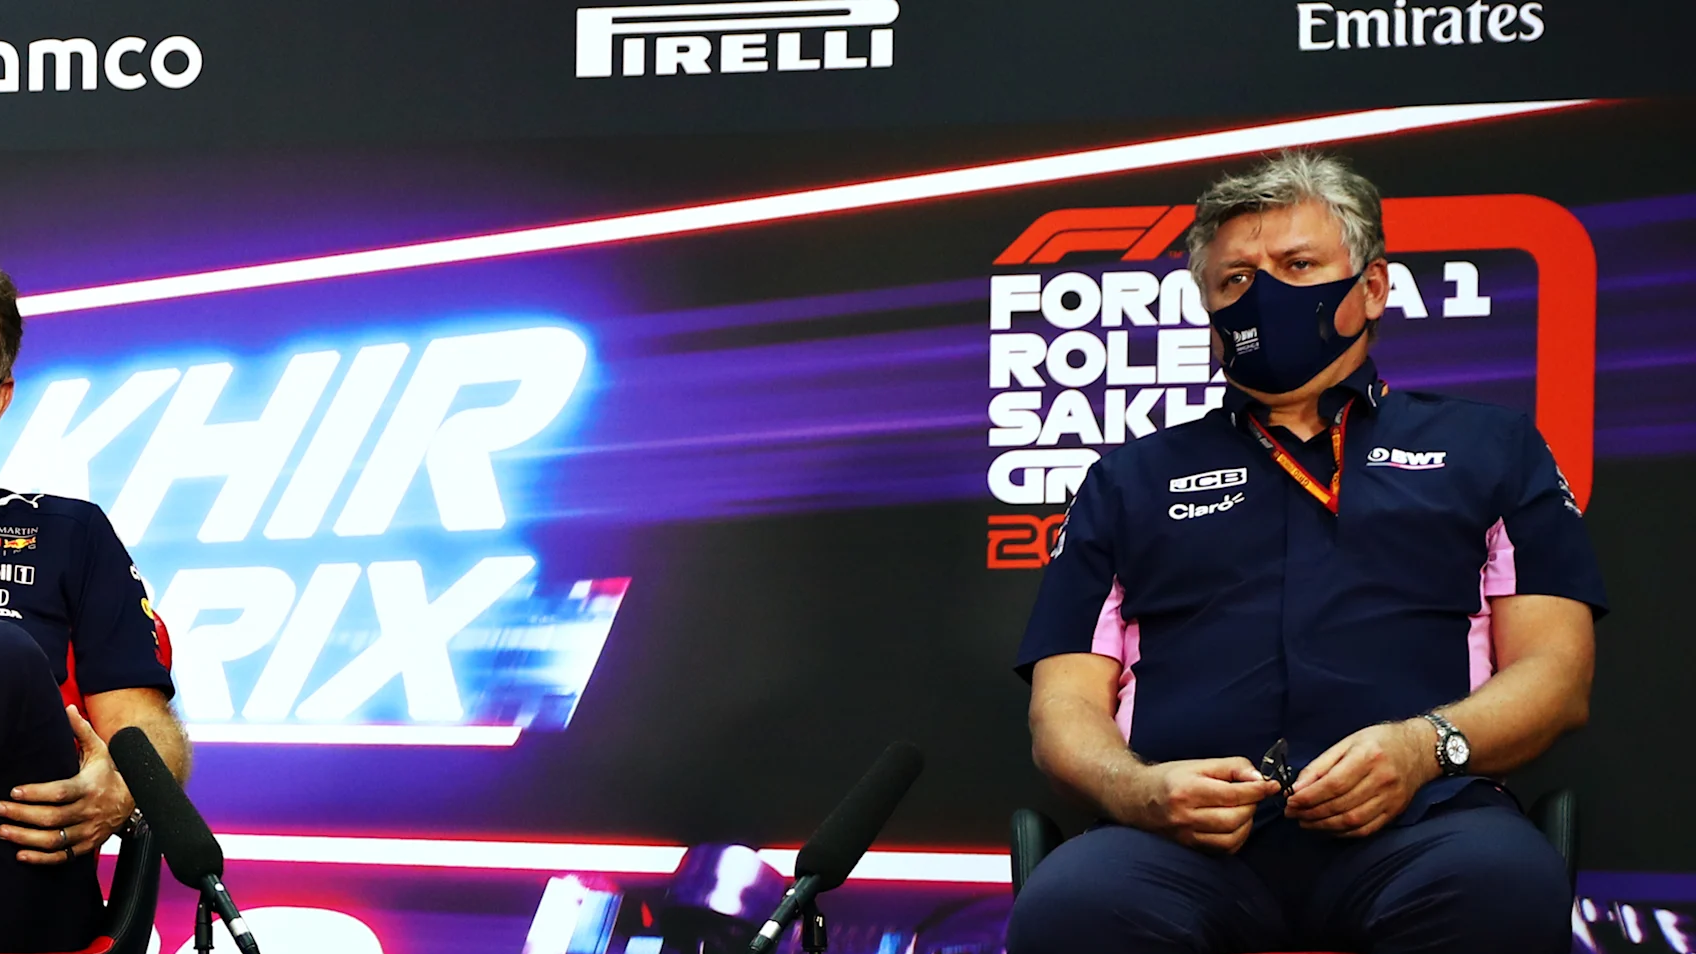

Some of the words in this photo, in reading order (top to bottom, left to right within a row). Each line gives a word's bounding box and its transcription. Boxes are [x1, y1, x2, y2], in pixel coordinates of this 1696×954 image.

[576, 0, 900, 78] PIRELLI
[1296, 0, 1545, 50] Emirates
[990, 261, 1429, 331] FORMA
[1443, 261, 1491, 317] 1
[989, 328, 1227, 389] ROLE
[988, 387, 1226, 447] SAKH
[1173, 471, 1243, 490] JCB
[1391, 448, 1447, 465] BWT
[1168, 496, 1236, 520] Claro
[147, 555, 536, 722] RIX
